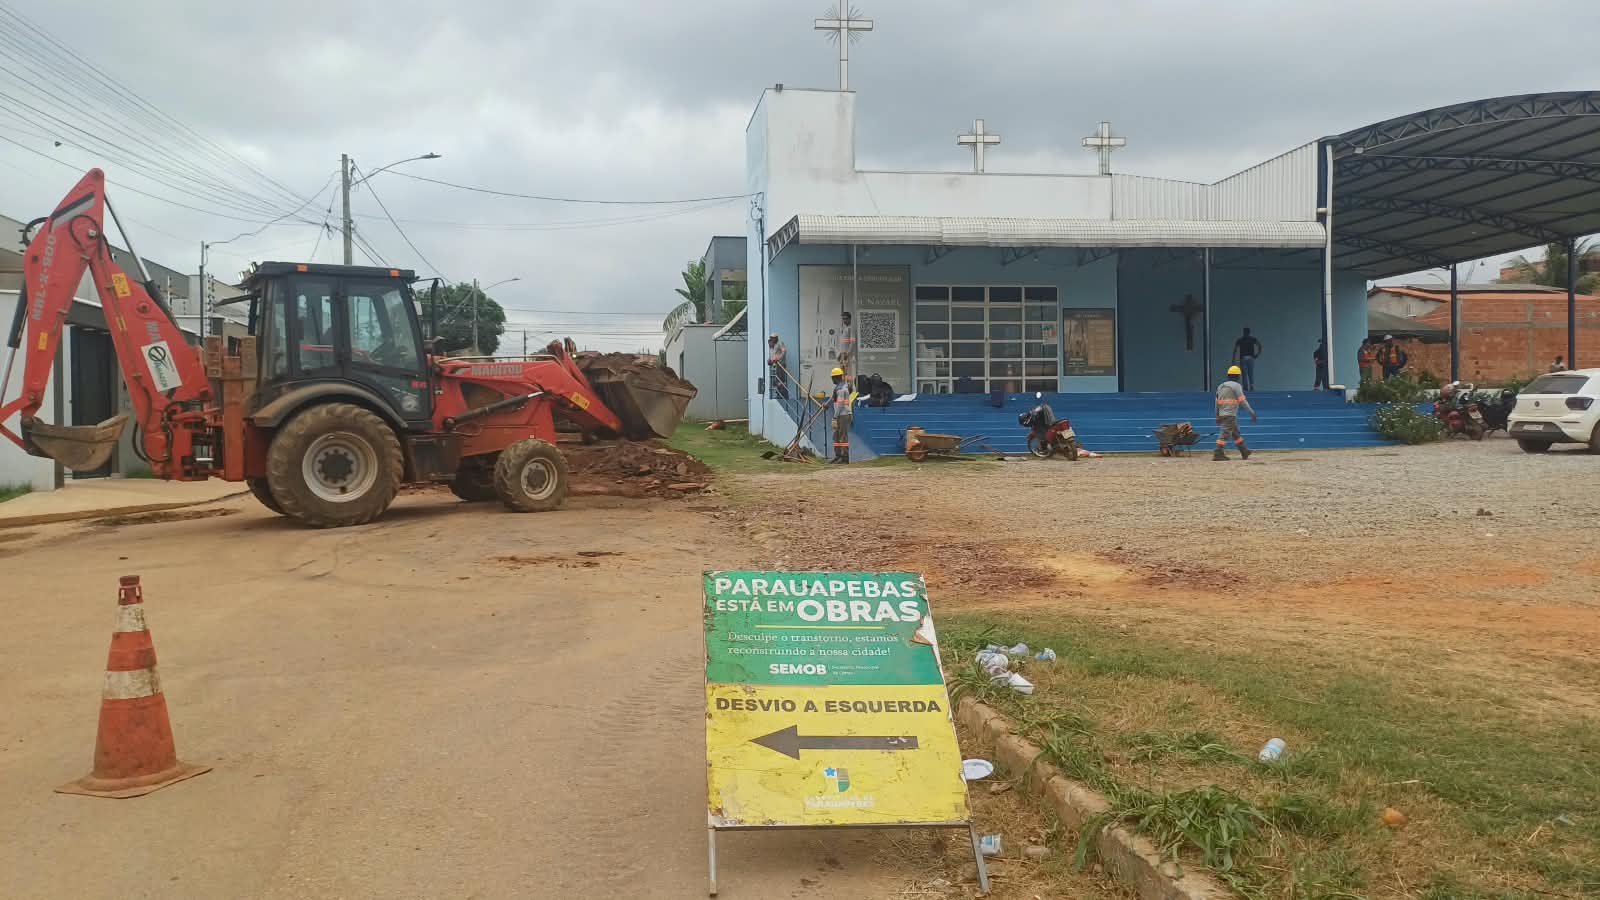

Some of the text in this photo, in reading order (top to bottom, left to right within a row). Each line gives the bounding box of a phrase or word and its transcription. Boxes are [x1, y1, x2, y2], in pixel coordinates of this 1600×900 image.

[471, 364, 523, 377] MANITOU
[715, 578, 917, 598] PARAUAPEBAS
[716, 597, 922, 622] ESTÁ EM OBRAS
[727, 631, 778, 644] Desculpe
[855, 634, 899, 643] estamos
[727, 647, 807, 656] reconstruindo
[819, 648, 849, 656] nossa
[851, 647, 891, 656] cidade!
[769, 663, 827, 675] SEMOB
[716, 697, 942, 713] DESVIO A ESQUERDA
